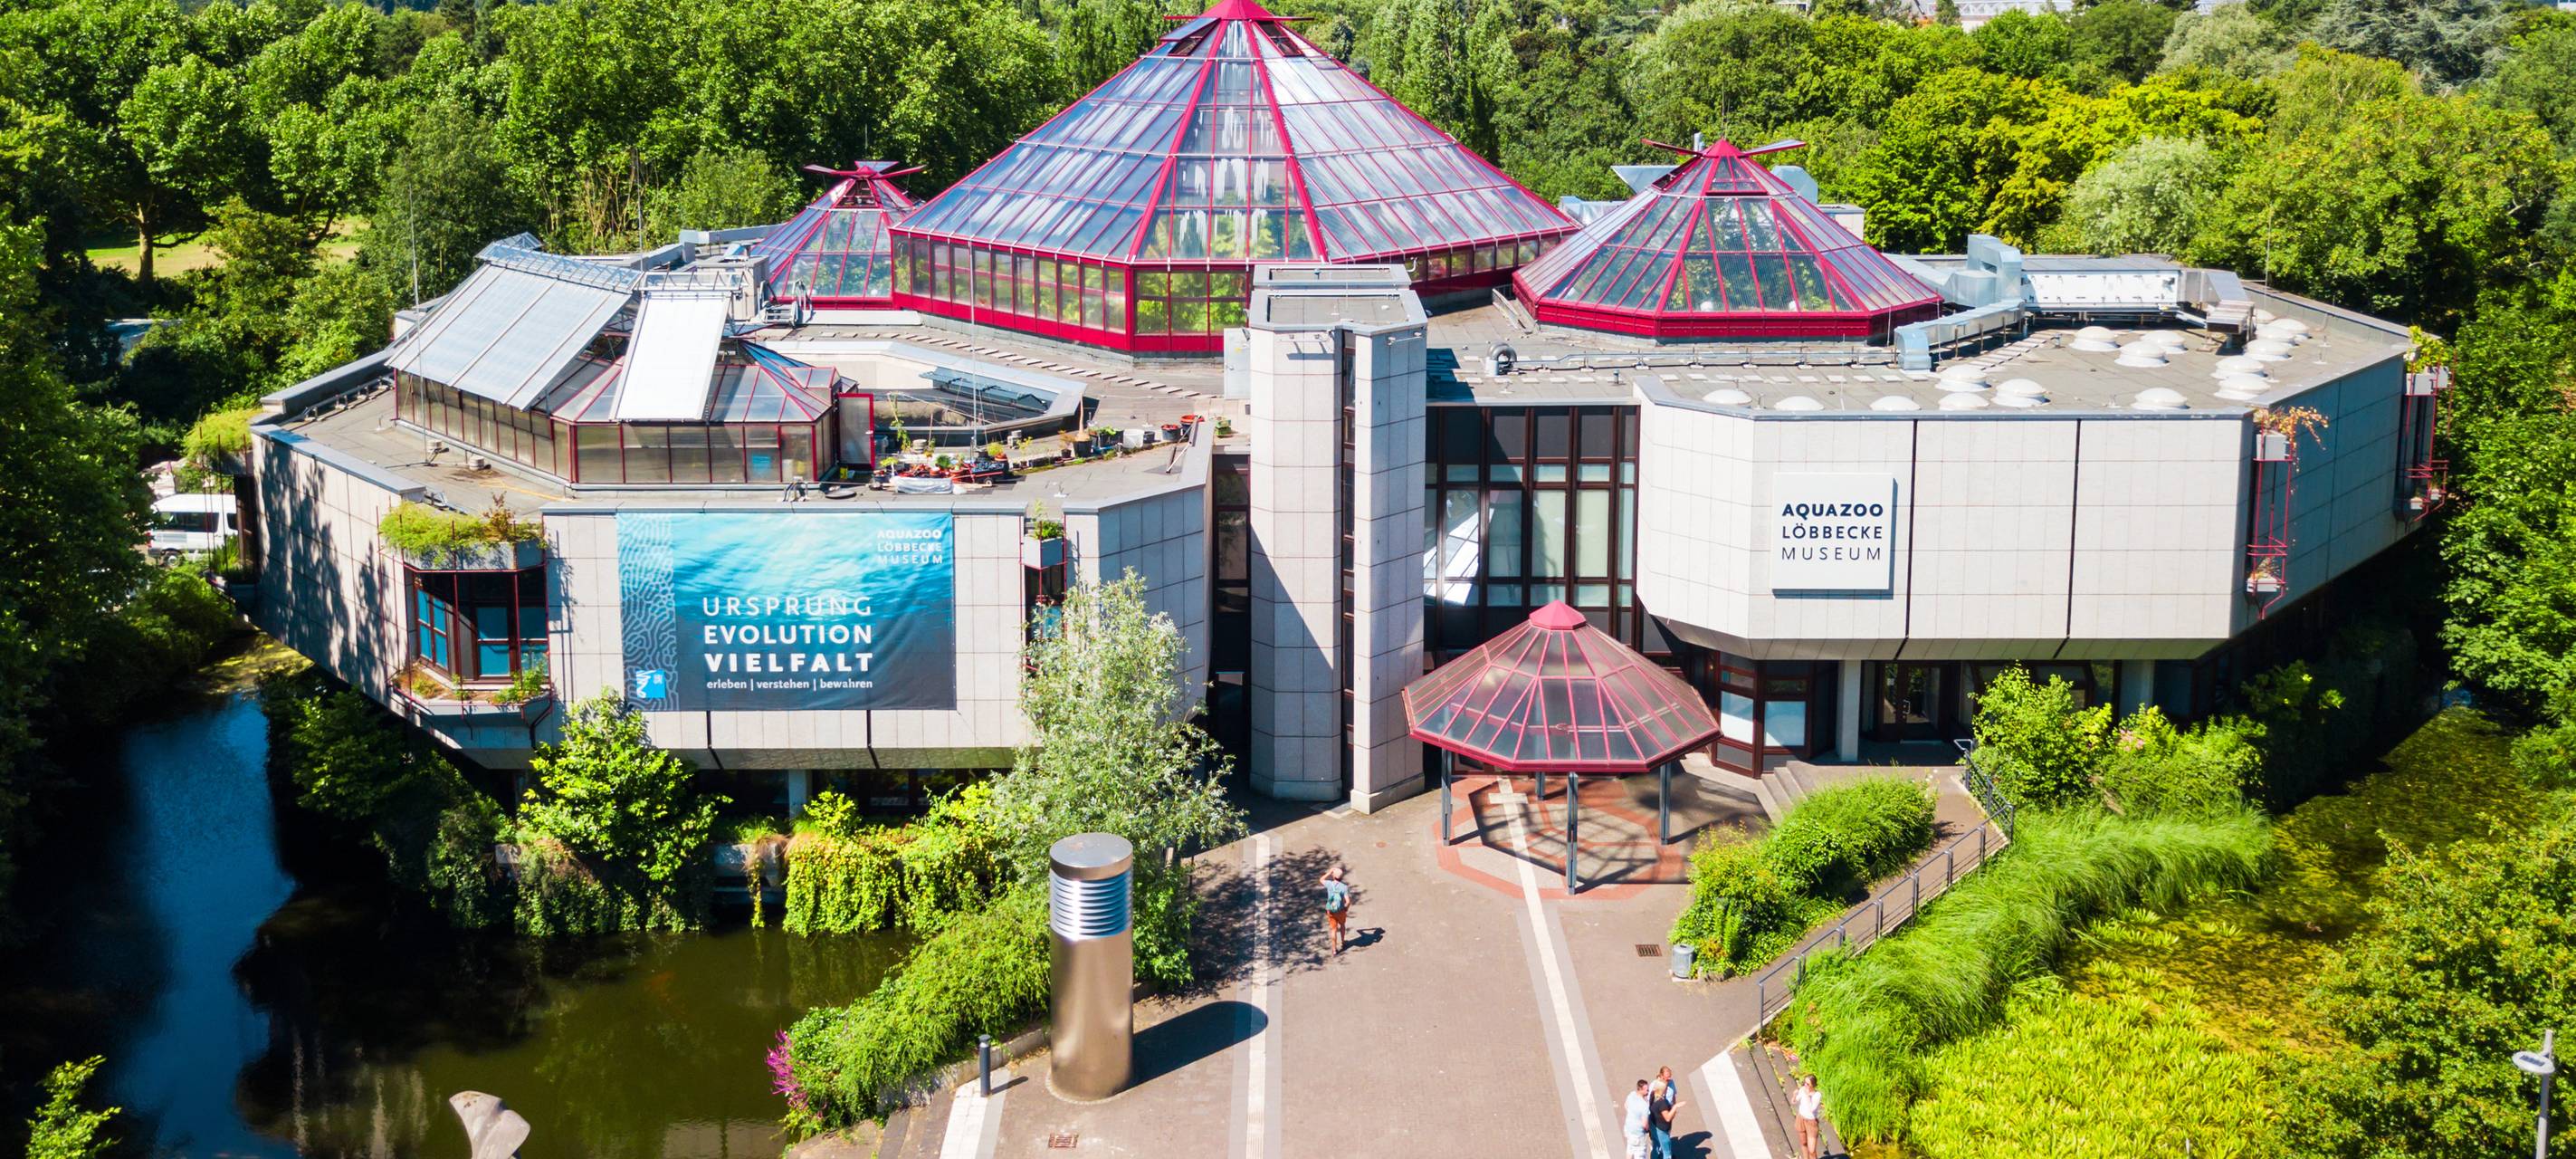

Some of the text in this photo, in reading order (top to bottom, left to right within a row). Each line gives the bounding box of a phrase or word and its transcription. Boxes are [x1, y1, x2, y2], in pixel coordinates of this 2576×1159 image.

[1781, 503, 1884, 521] AQUAZOO
[877, 529, 942, 539] AQUAZOO
[1782, 522, 1883, 539] LÖBBECKE
[877, 541, 942, 551] LÖBBECKE
[1781, 547, 1881, 560] MUSEUM
[876, 554, 943, 564] MUSEUM
[702, 597, 872, 617] URSPRUNG
[703, 625, 873, 644] EVOLUTION
[704, 653, 873, 672] VIELFALT
[706, 678, 747, 689] erleben
[757, 678, 810, 689] verstehen
[820, 678, 873, 689] bewahren
